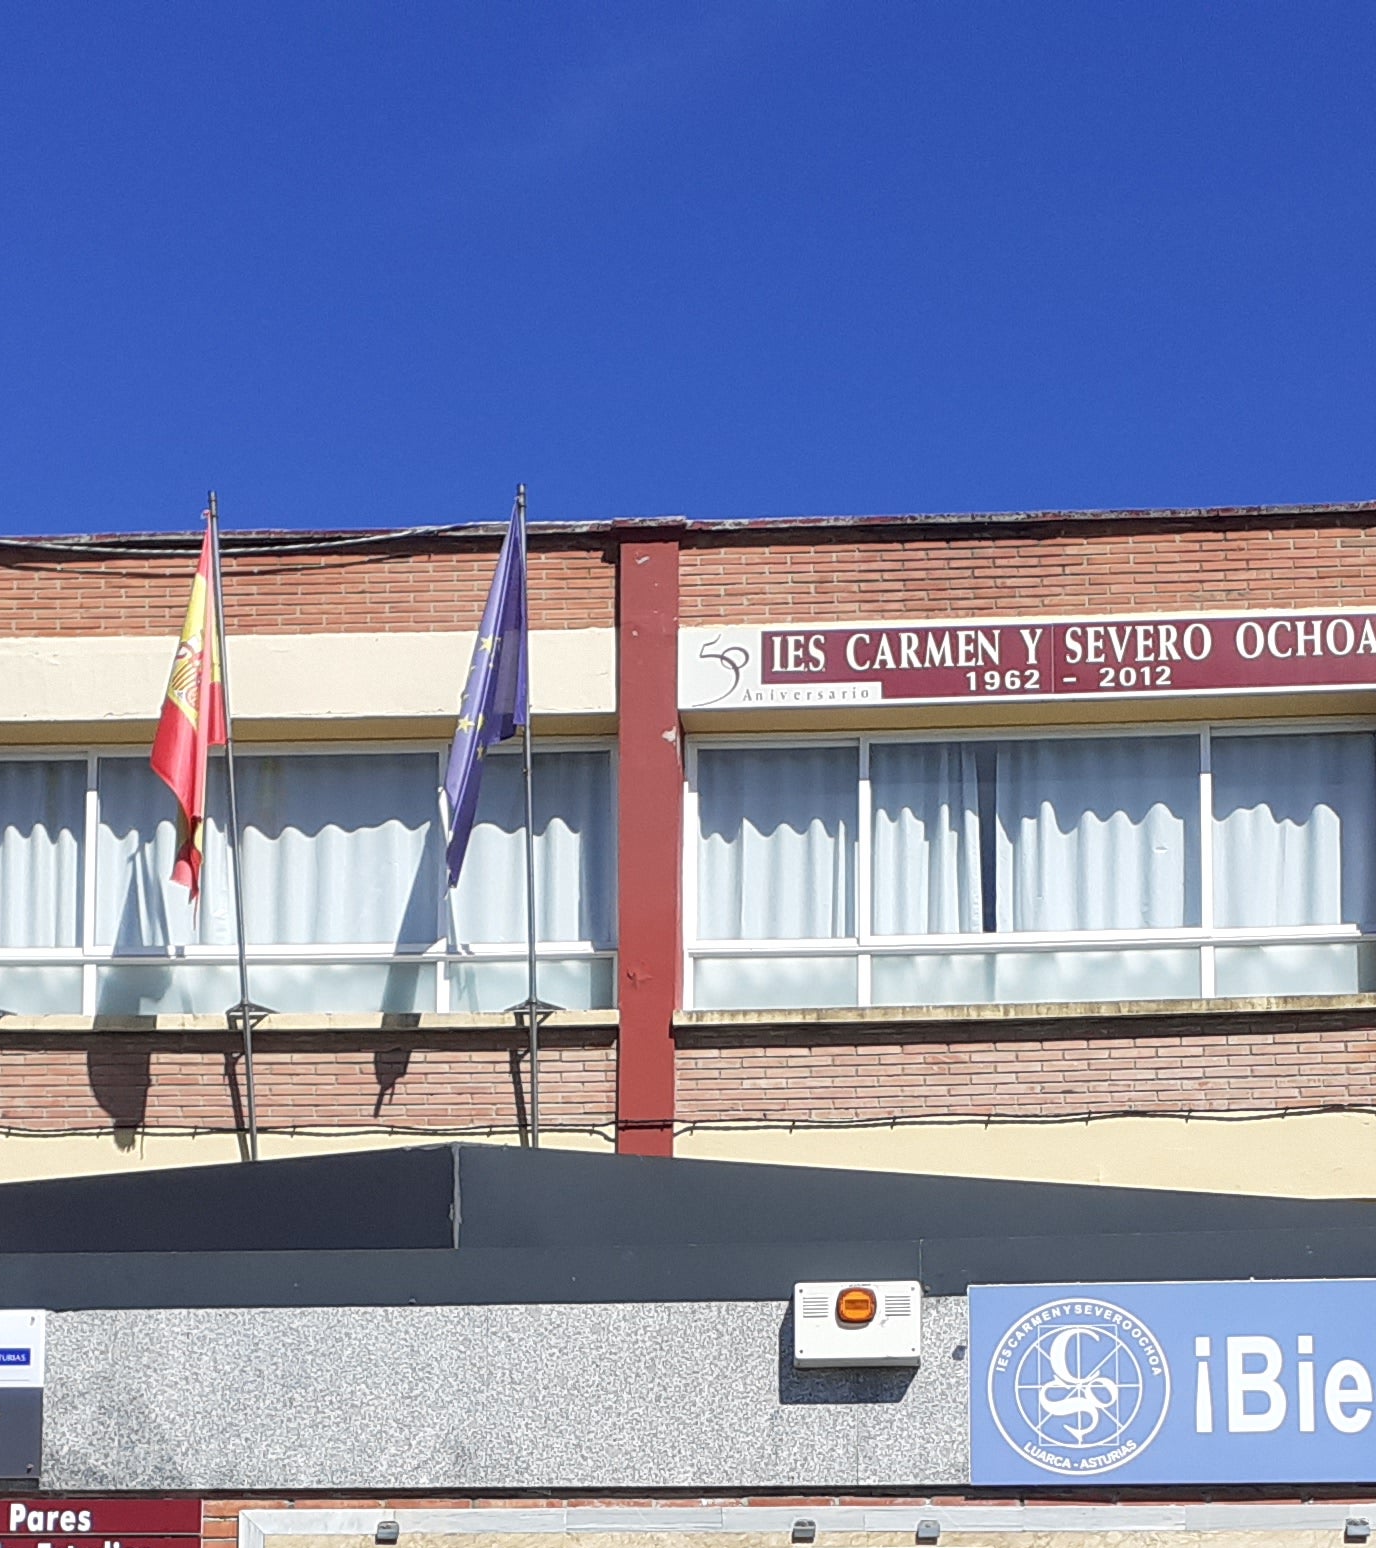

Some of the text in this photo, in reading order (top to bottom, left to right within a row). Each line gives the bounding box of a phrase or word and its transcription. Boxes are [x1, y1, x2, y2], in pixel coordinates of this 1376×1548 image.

[845, 629, 1001, 671] CARMEN
[1018, 627, 1044, 665] Y
[1064, 623, 1213, 664] SEVERO
[965, 669, 1041, 692] 1962
[1099, 665, 1172, 688] 2012
[742, 687, 869, 702] Aniversario
[1023, 1442, 1071, 1468] LUARCA
[1080, 1440, 1137, 1469] ASTURIAS
[10, 1503, 91, 1532] Pares
